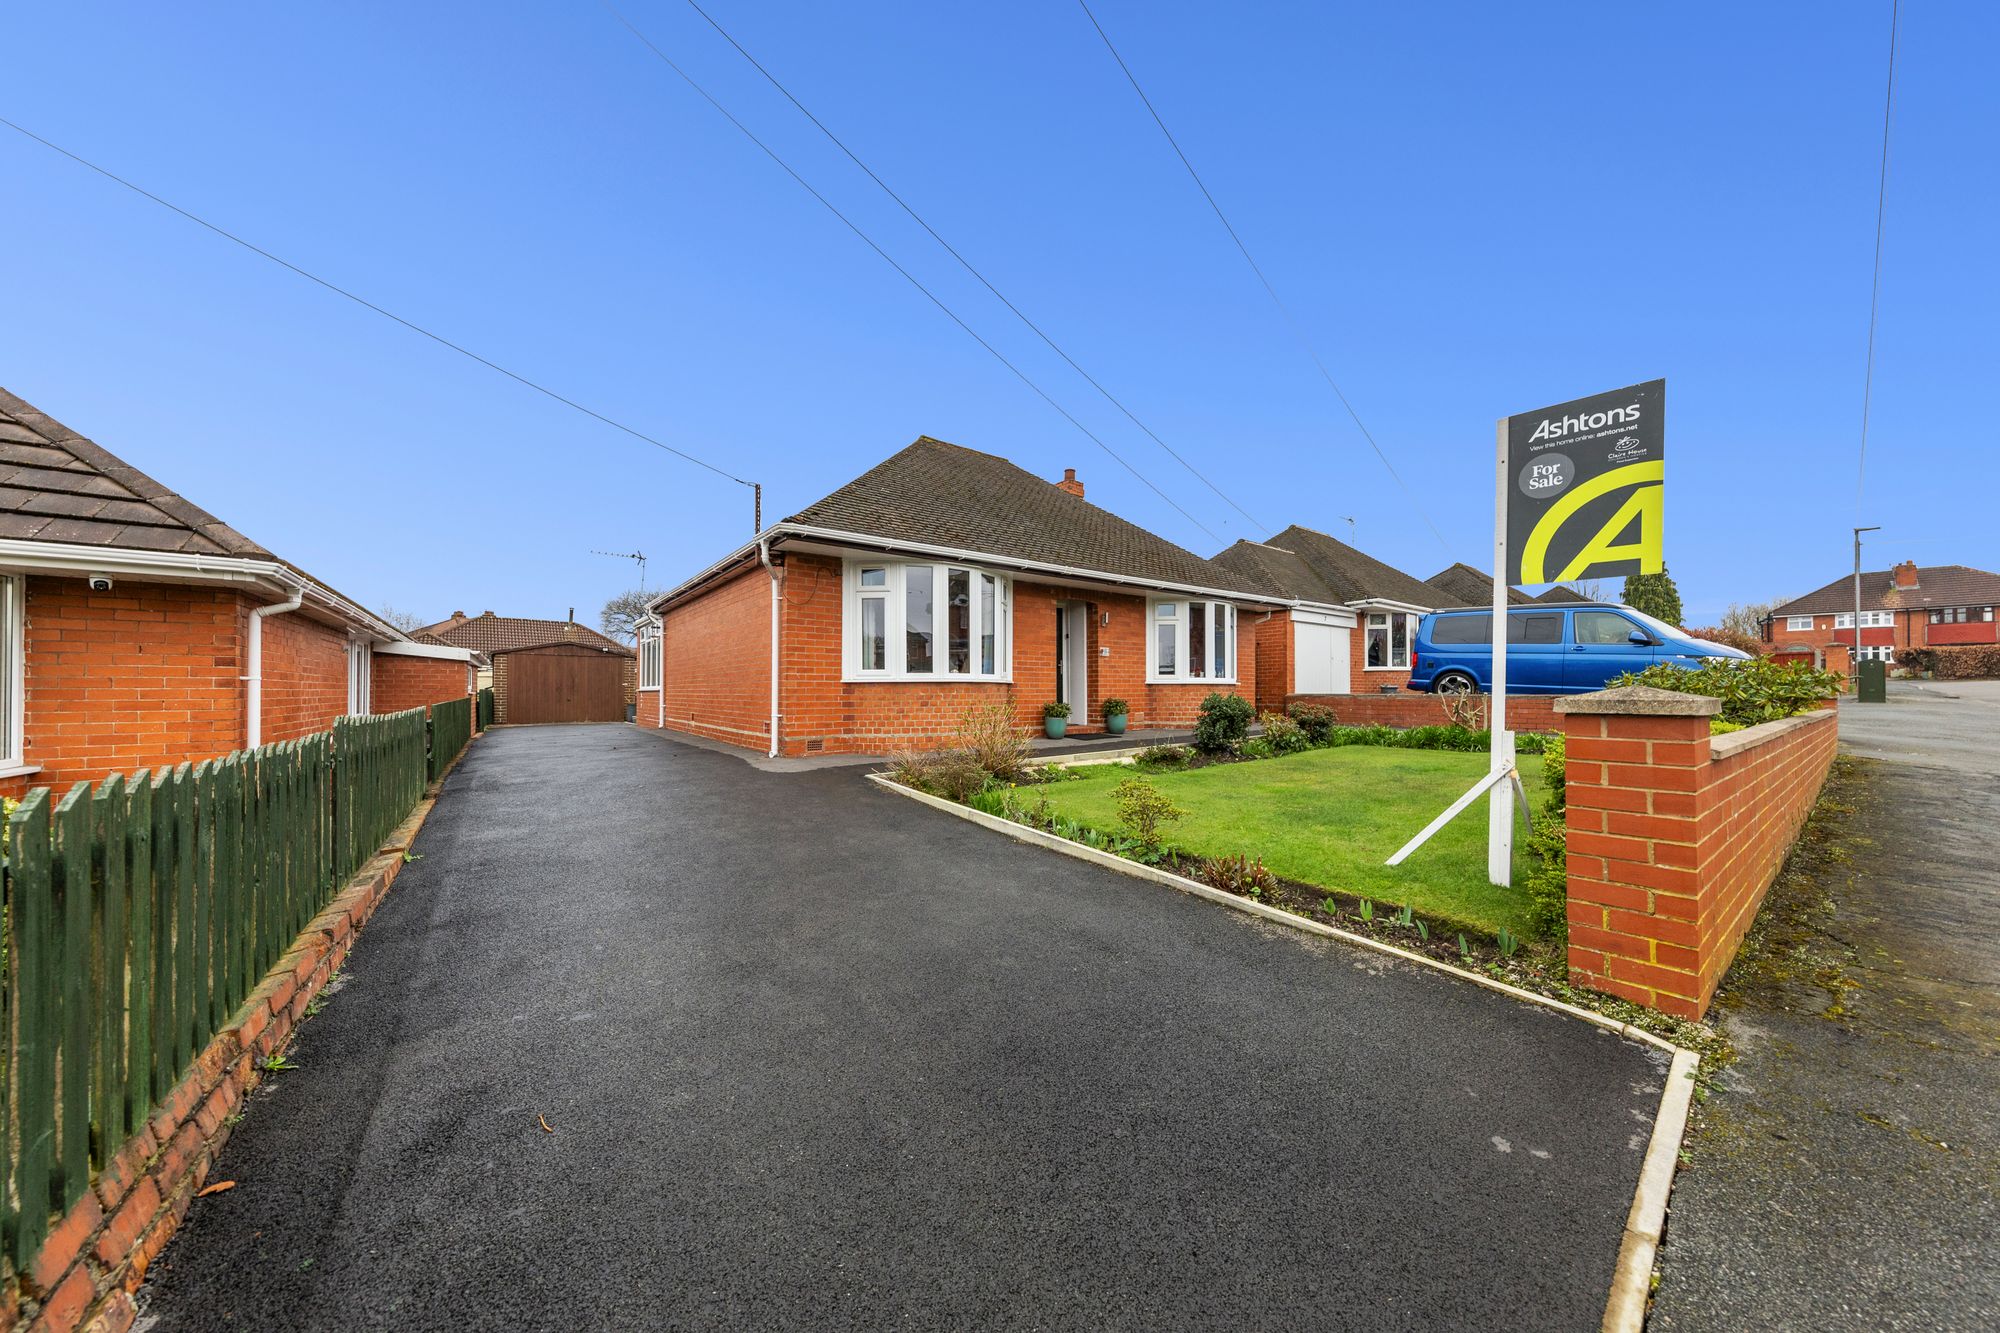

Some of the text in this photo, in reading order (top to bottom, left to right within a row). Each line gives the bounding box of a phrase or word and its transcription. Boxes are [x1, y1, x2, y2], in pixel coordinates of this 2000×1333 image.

[1528, 404, 1641, 443] Ashtons
[1529, 444, 1544, 452] View
[1556, 438, 1574, 447] home
[1574, 433, 1595, 442] online:
[1596, 424, 1638, 438] ashtons.net
[1532, 463, 1561, 478] For
[1529, 474, 1563, 490] Sale
